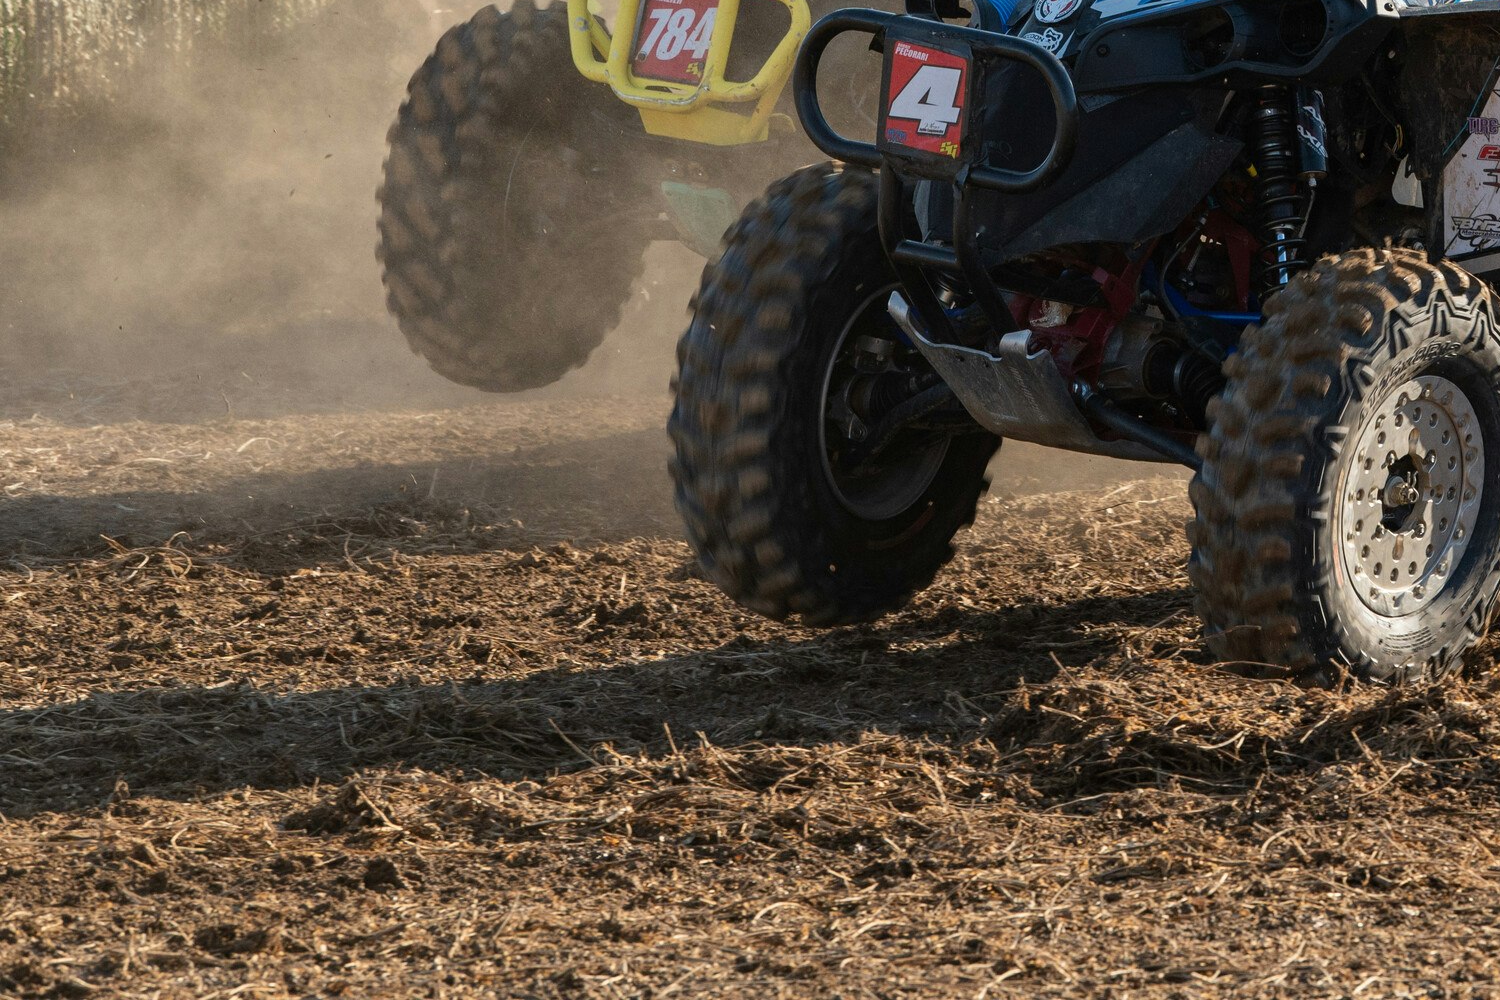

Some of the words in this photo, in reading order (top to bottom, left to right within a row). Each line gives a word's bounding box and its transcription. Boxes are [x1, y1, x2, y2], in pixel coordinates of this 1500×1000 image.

[634, 7, 719, 61] 784
[895, 46, 929, 61] PECORARI
[888, 65, 962, 136] 4
